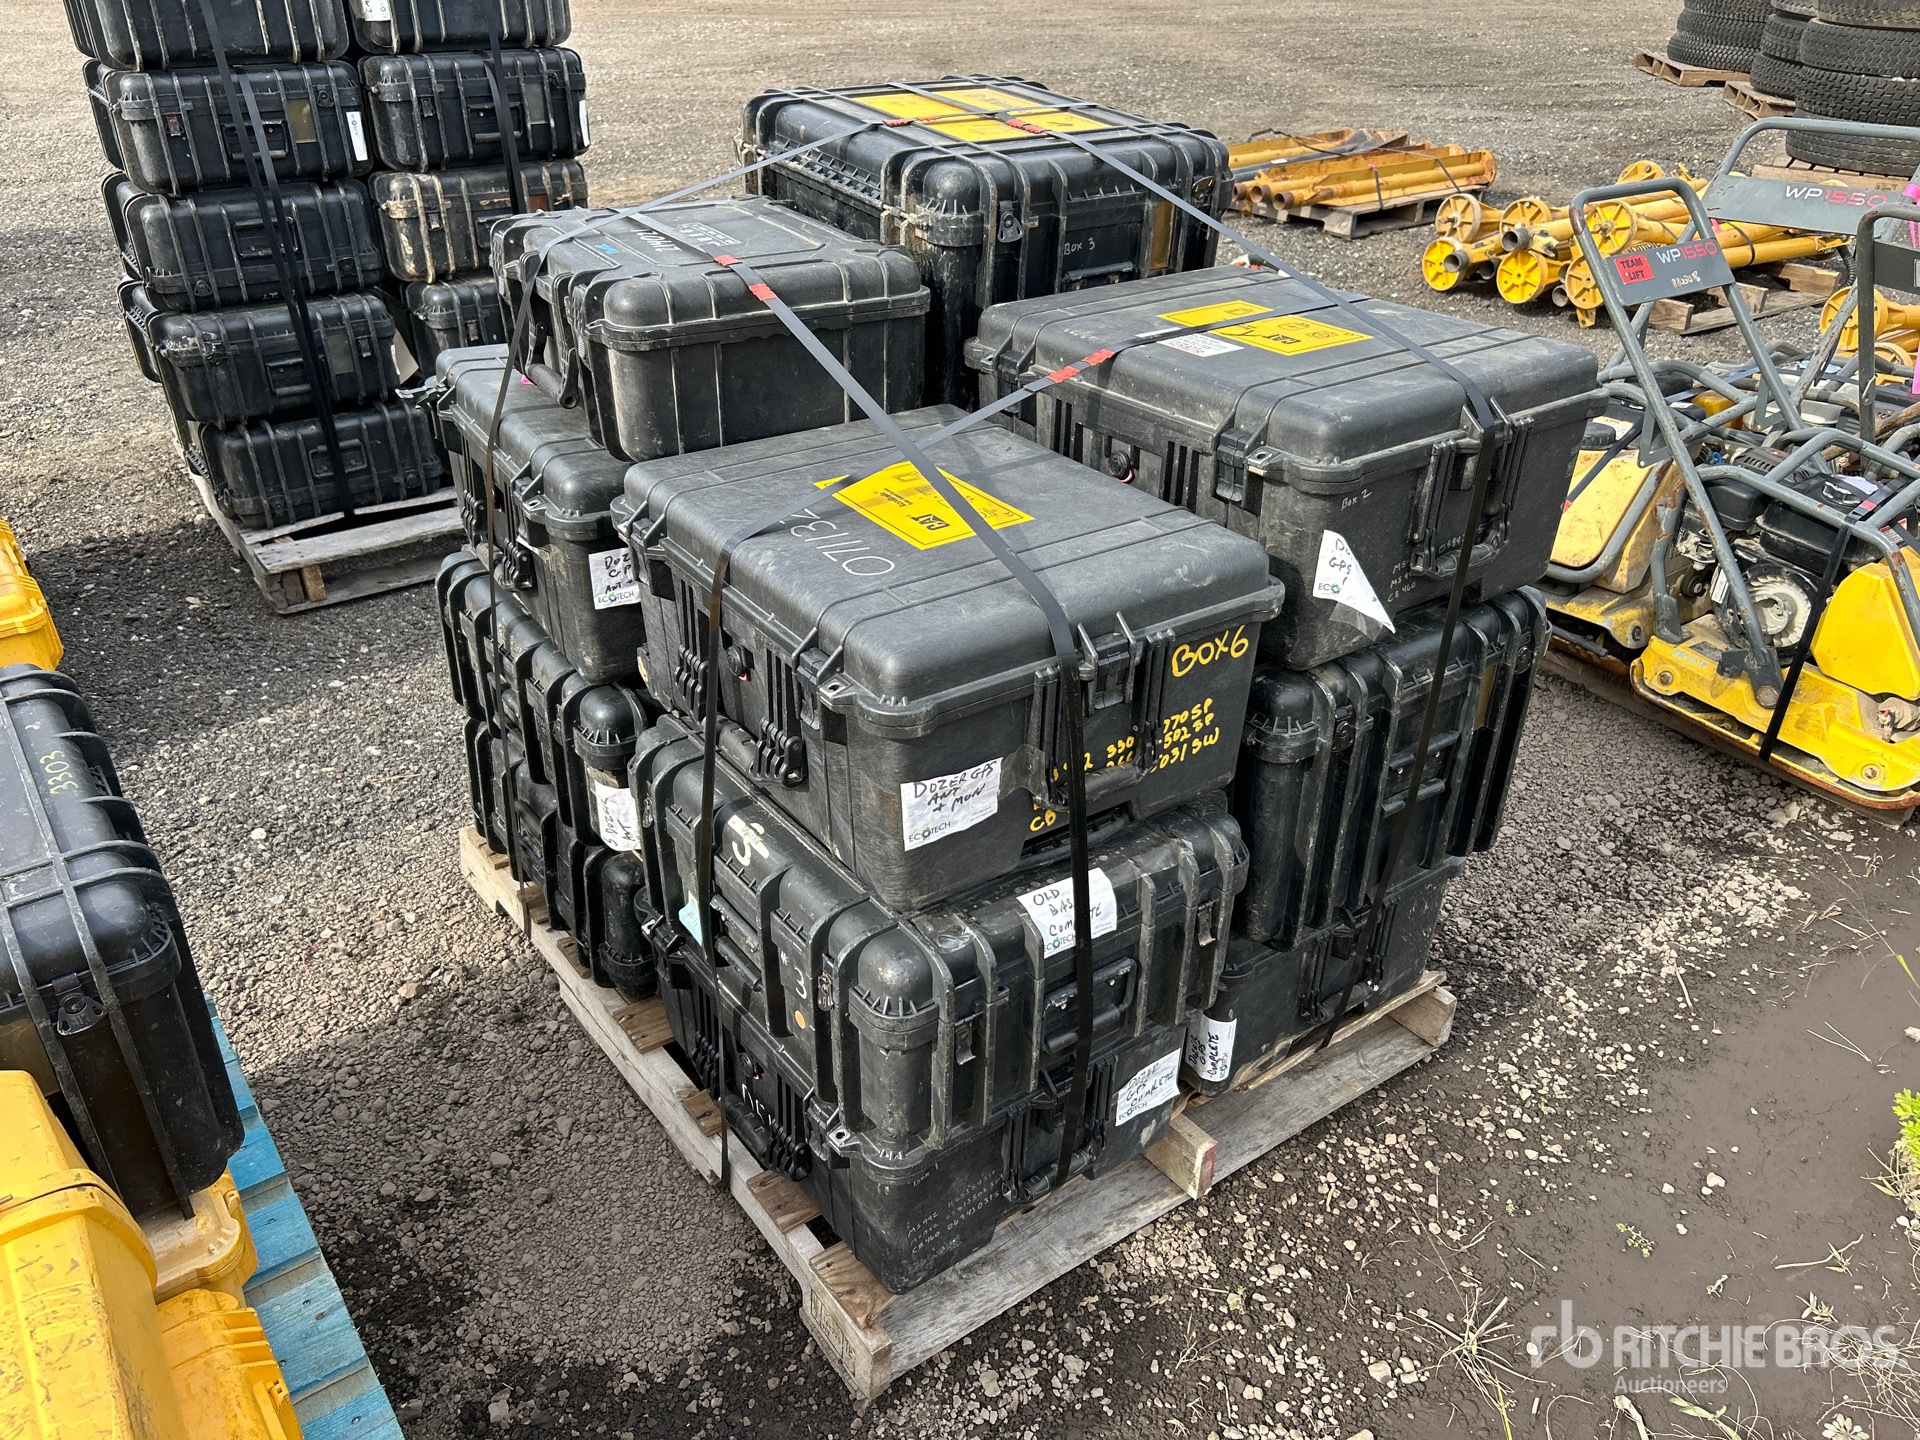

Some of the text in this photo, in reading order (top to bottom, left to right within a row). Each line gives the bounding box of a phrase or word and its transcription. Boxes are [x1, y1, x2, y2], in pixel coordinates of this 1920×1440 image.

[1785, 186, 1888, 207] WP1550
[1088, 237, 1096, 250] 3
[1656, 241, 1718, 264] WP1550
[1620, 257, 1643, 270] TEAM
[1628, 269, 1646, 280] LIFT
[1262, 333, 1301, 344] CAT
[1361, 489, 1372, 499] 2
[910, 514, 950, 531] CAT
[913, 760, 997, 799] DOZER GPS
[927, 787, 961, 806] ANT
[951, 782, 986, 812] MON
[908, 821, 951, 843] ECOTECH
[1033, 889, 1060, 906] OLD
